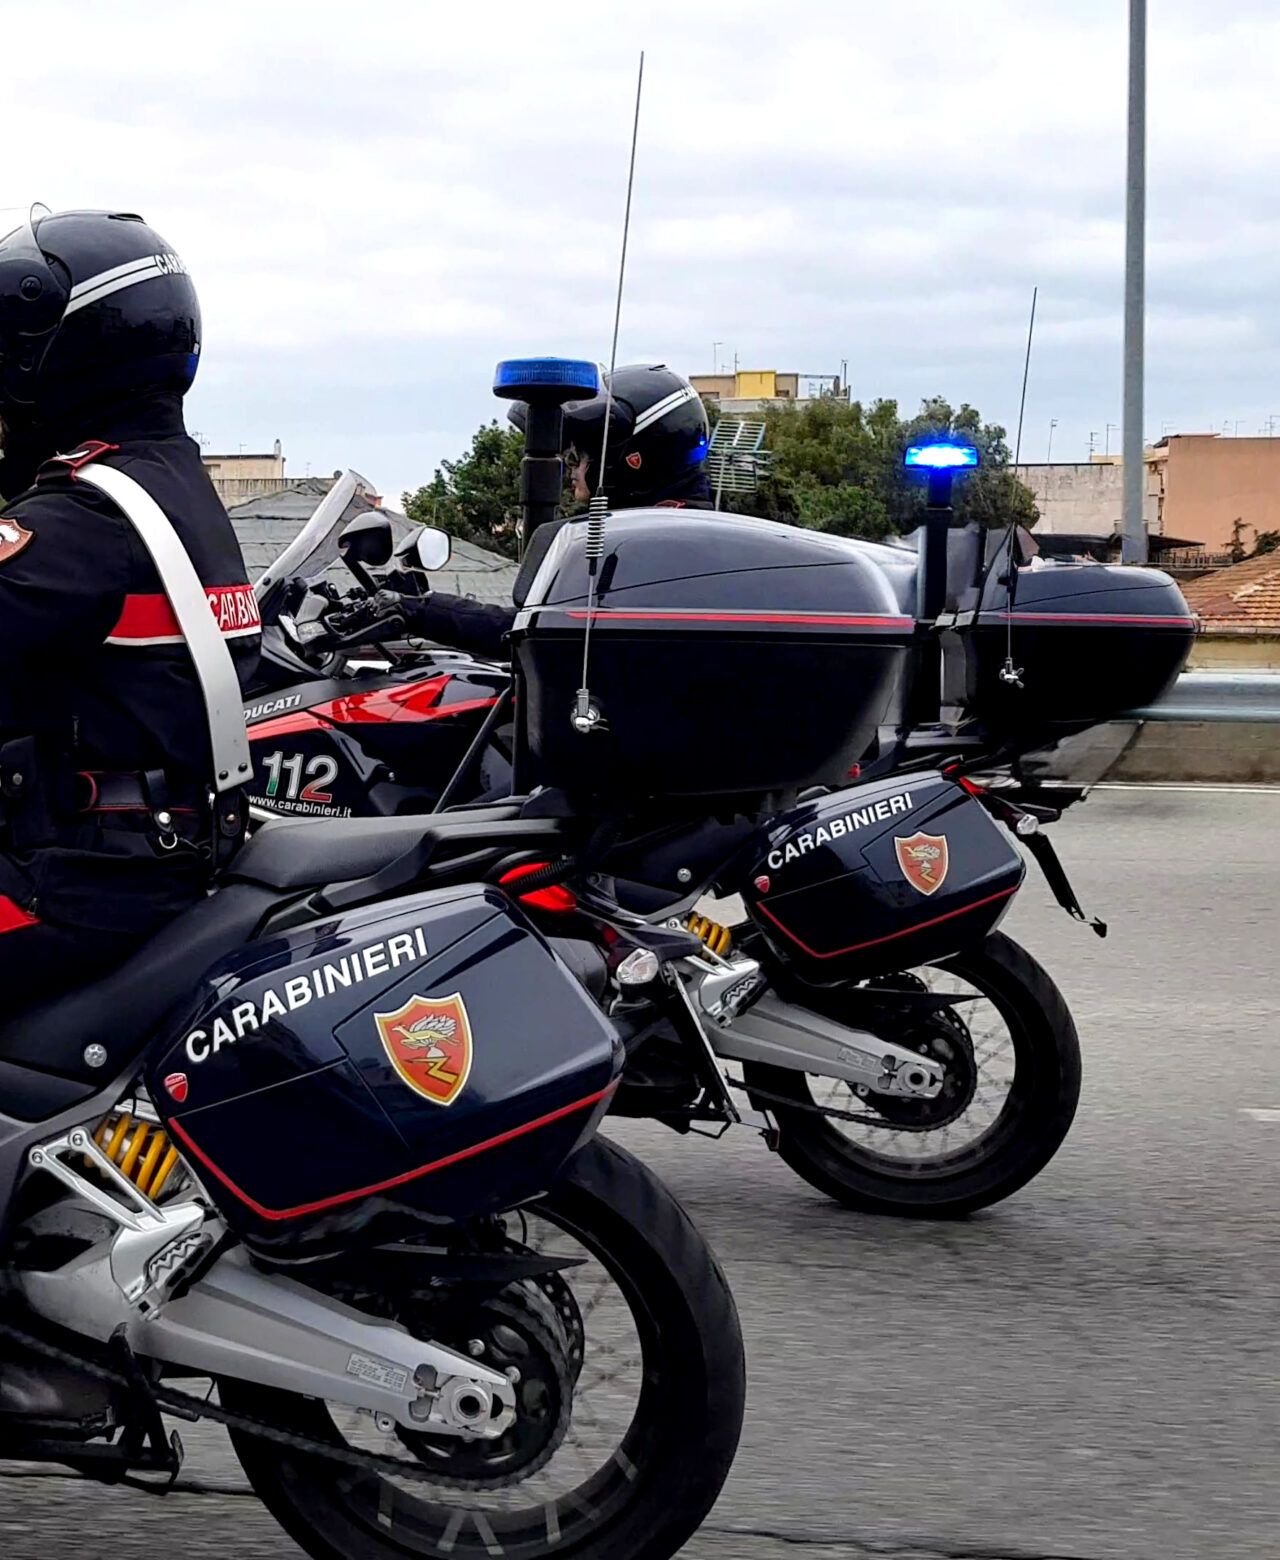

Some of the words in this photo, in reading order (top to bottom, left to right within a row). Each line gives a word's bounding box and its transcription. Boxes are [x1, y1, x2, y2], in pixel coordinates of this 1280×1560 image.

[248, 794, 352, 818] www.carabinieri.it
[261, 750, 339, 803] 112
[767, 791, 914, 870] CARABINIERI
[185, 926, 429, 1064] CARABINIERI
